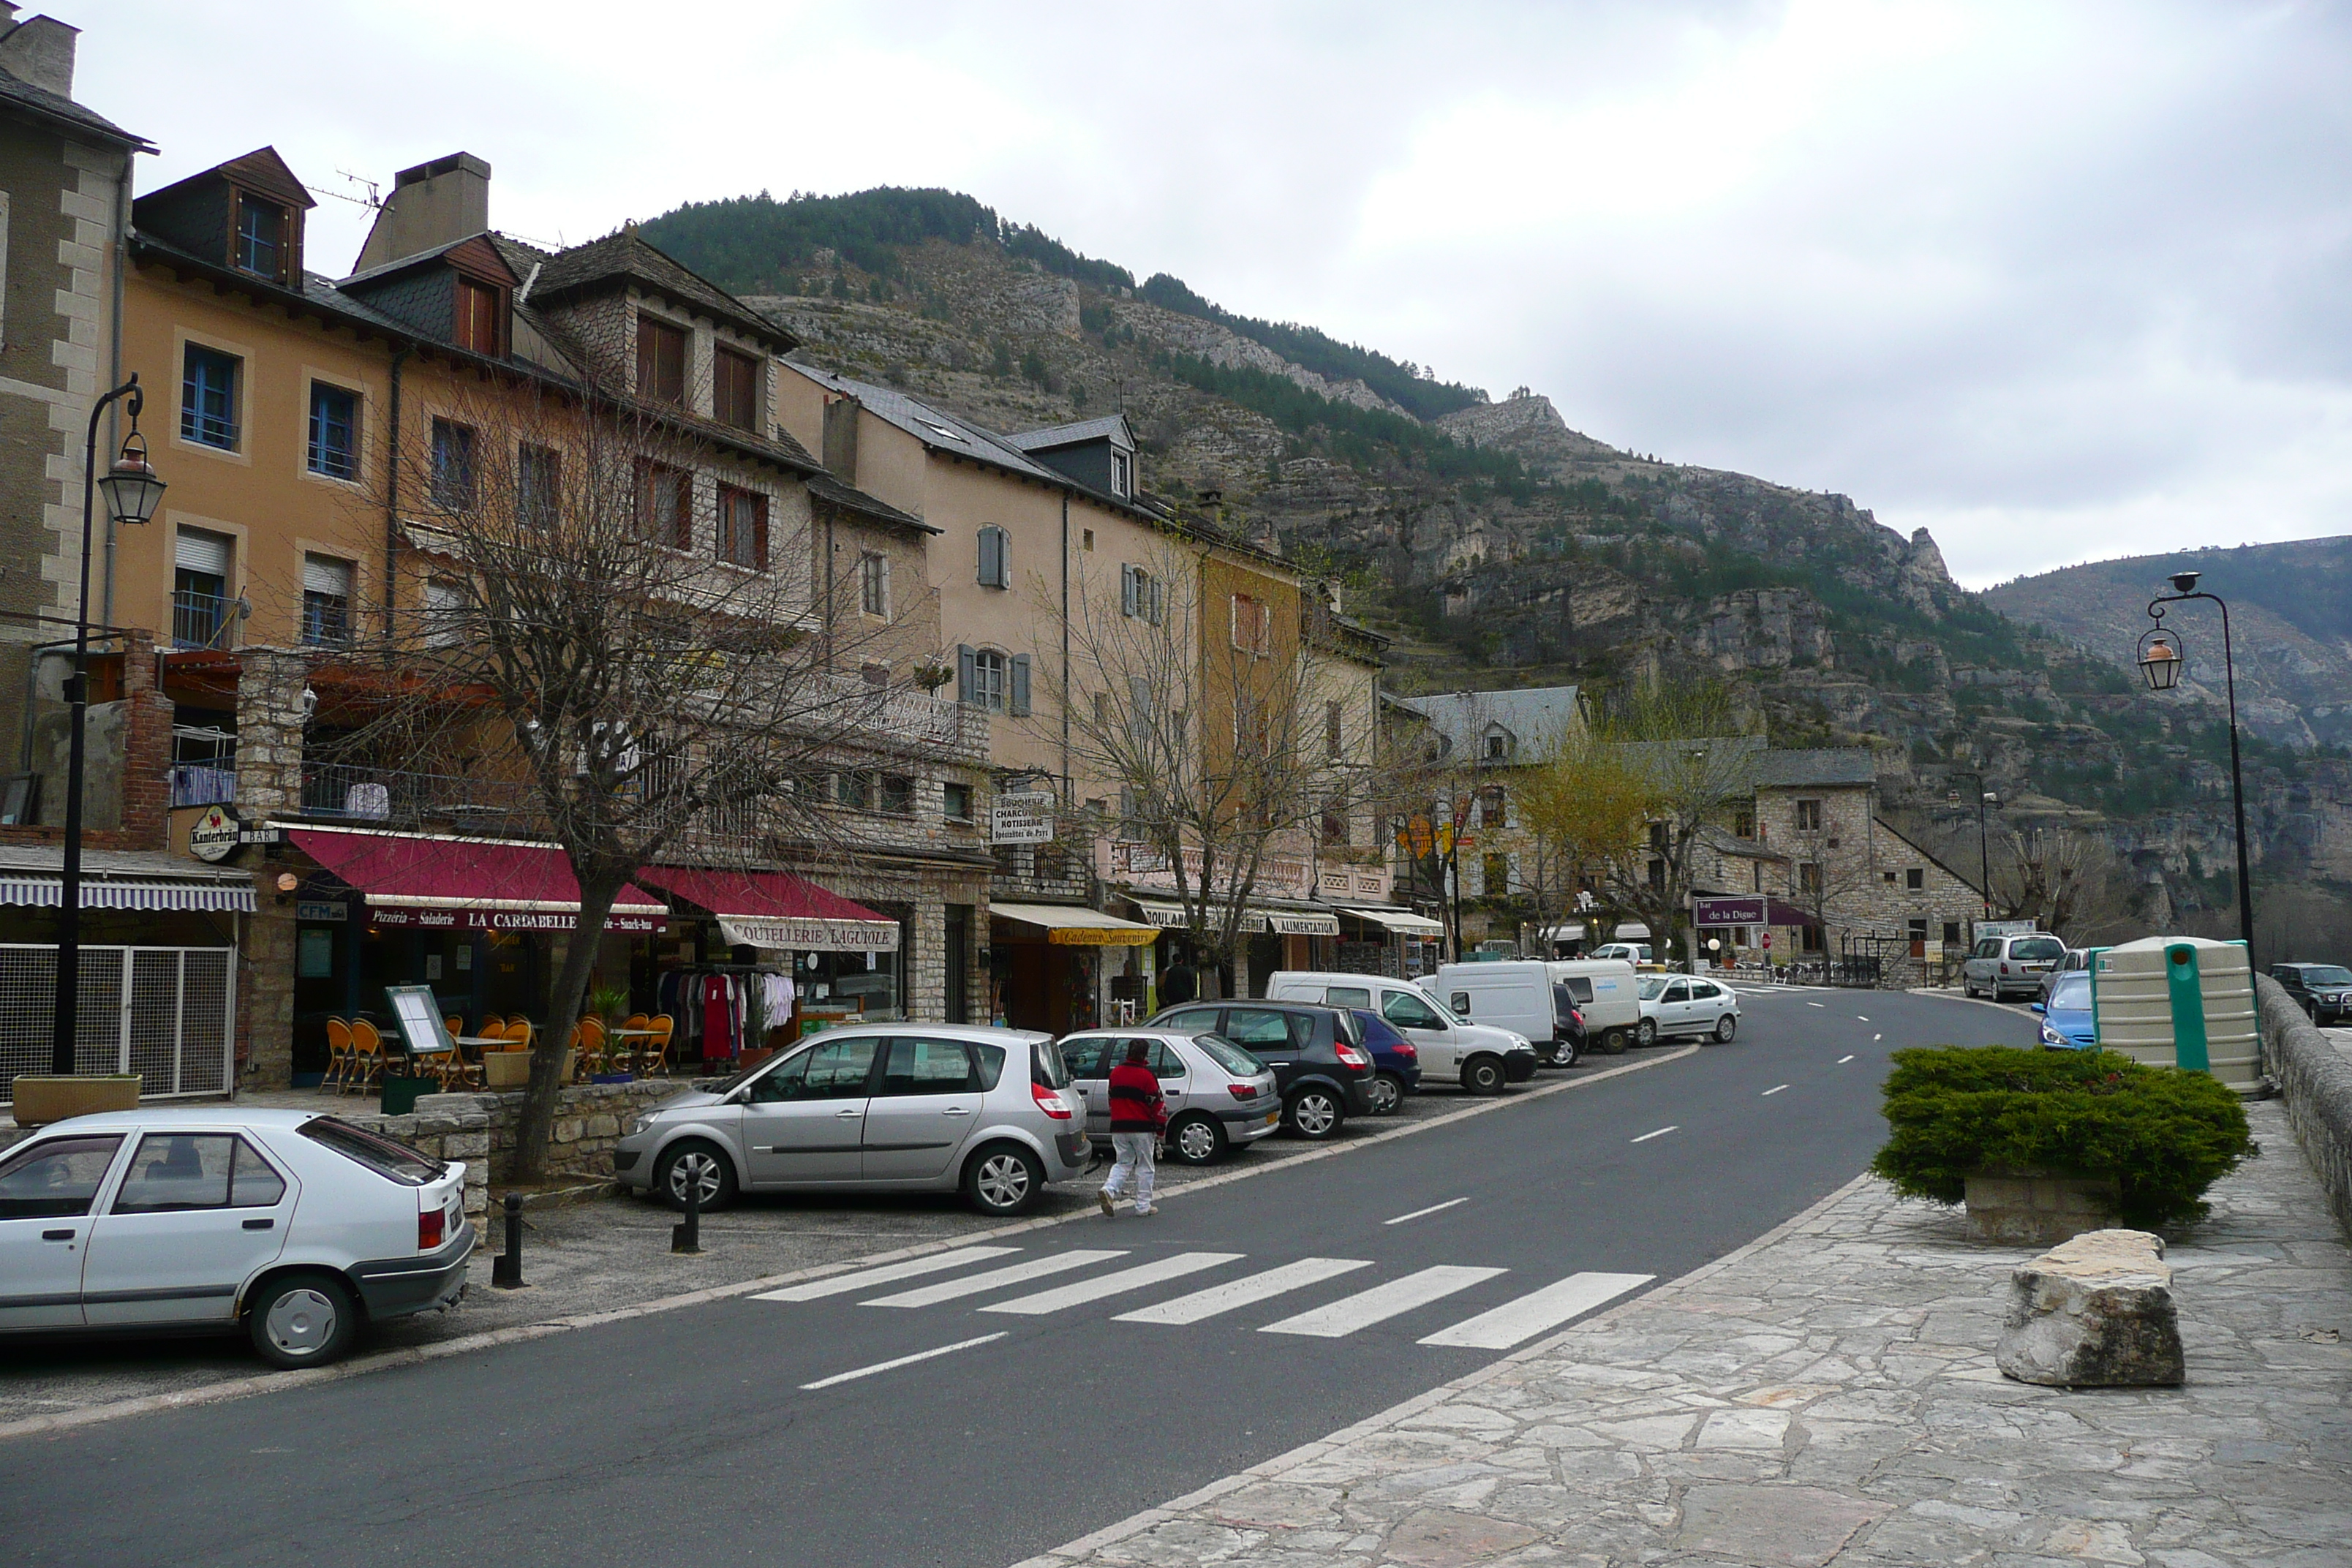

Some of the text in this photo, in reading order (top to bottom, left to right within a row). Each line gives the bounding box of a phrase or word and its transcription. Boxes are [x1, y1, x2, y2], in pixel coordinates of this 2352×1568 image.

[1001, 819, 1044, 828] ROTISSERIE
[192, 829, 238, 845] Kanterbräu
[249, 830, 271, 842] BAR
[995, 829, 1024, 840] Spécialités
[1035, 829, 1048, 840] Pays
[299, 905, 330, 919] CFM
[1708, 910, 1757, 920] de la Digue
[372, 910, 407, 924] Pizzéria
[418, 911, 455, 925] Saladerie
[468, 913, 486, 927] LA
[494, 913, 577, 929] CARDABELLE
[1281, 919, 1334, 934] ALIMENTATION
[830, 928, 890, 945] LAGUIOLE
[1064, 930, 1148, 943] Cadeaux Souvenirs
